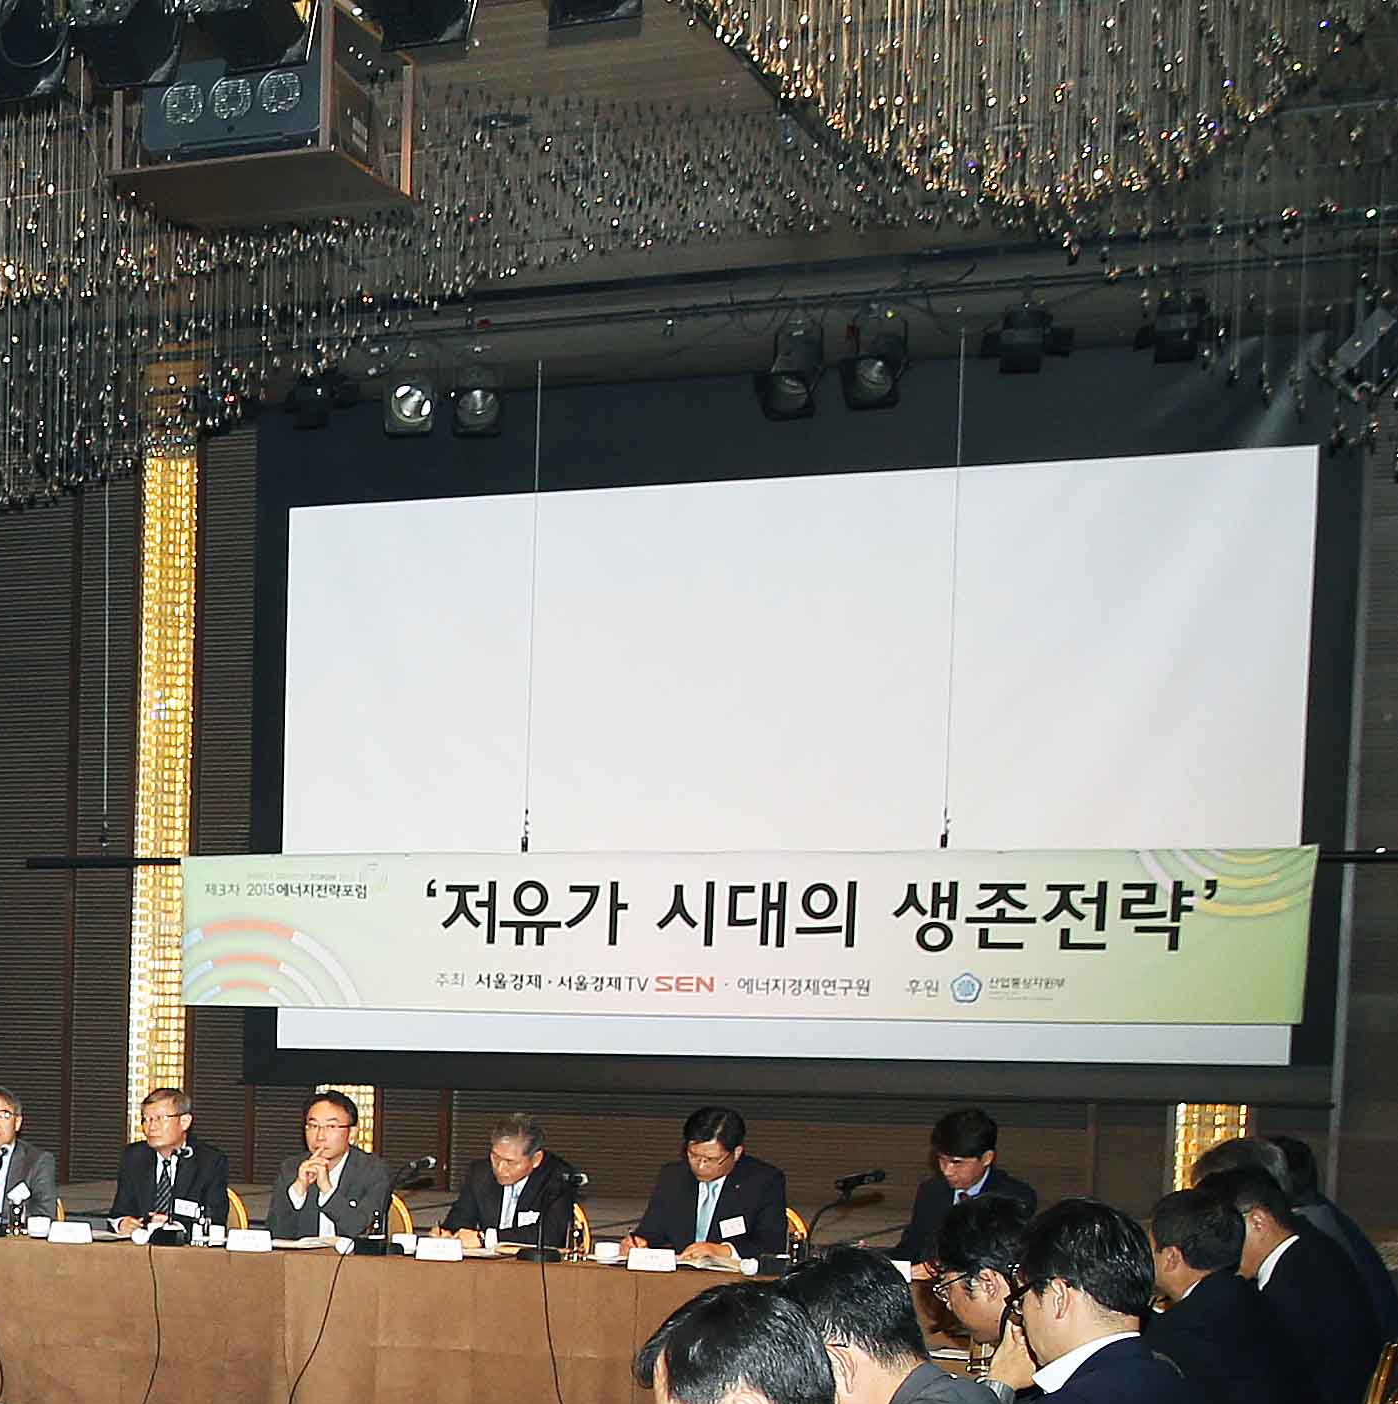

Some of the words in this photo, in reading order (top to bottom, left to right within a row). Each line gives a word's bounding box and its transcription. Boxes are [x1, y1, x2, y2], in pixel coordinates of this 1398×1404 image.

[205, 883, 240, 897] 제3차
[656, 881, 858, 948] 시대의
[435, 971, 466, 987] 주최
[655, 976, 715, 992] SEN
[905, 978, 939, 998] 후원
